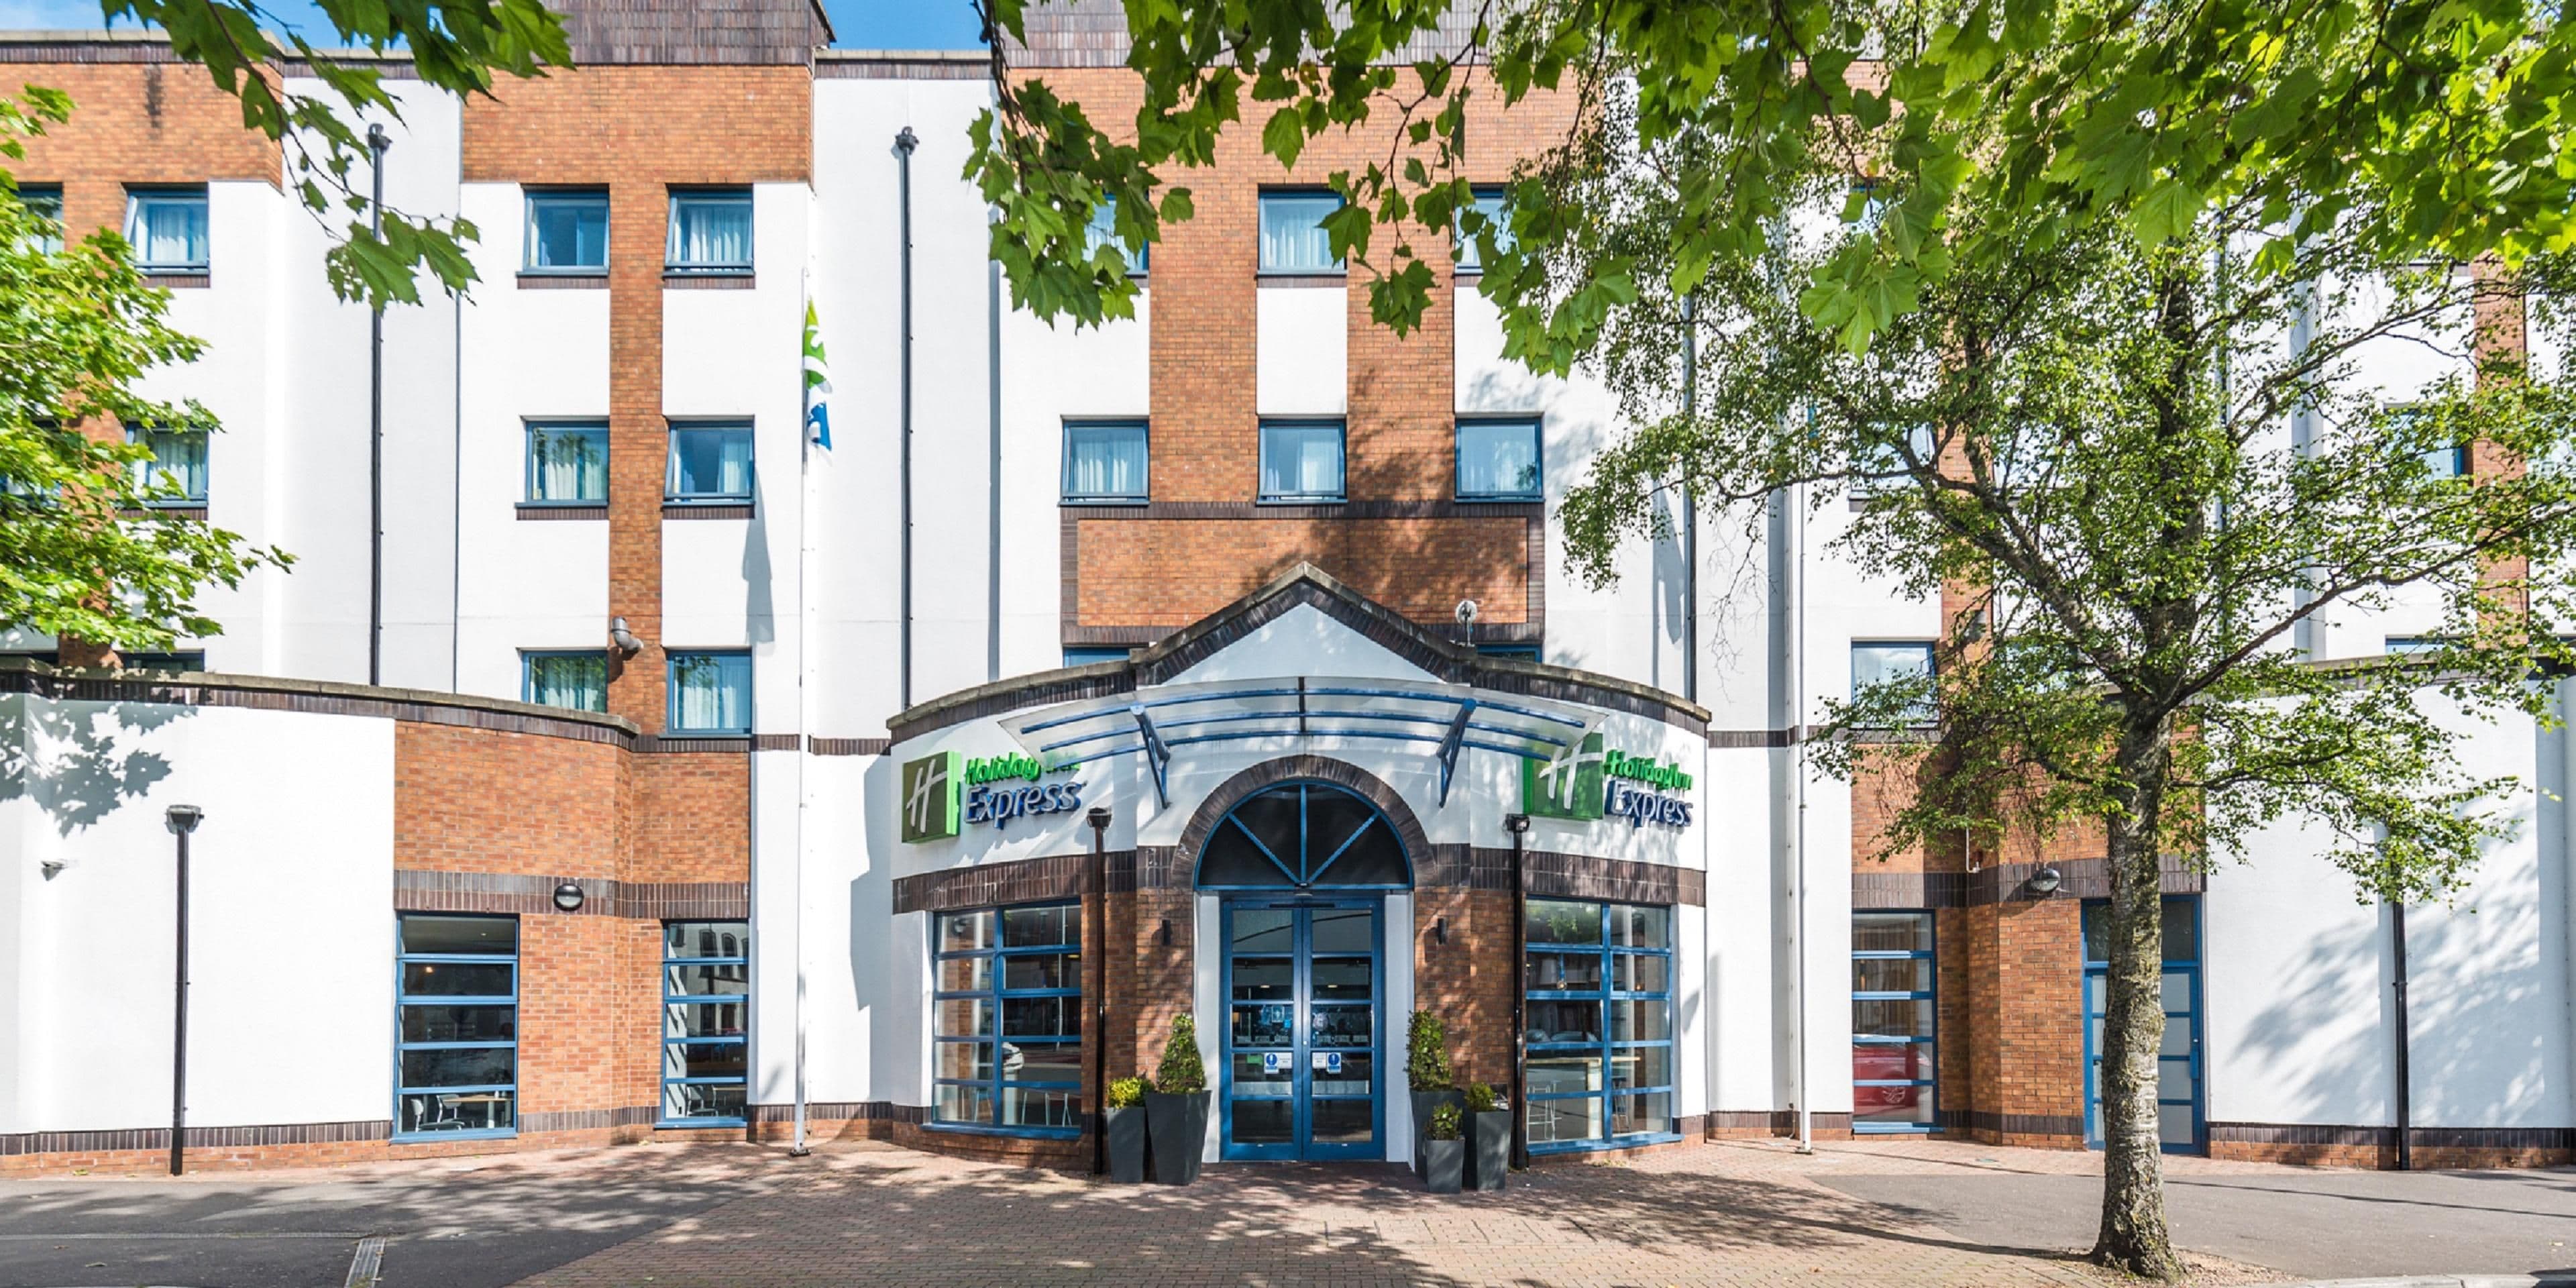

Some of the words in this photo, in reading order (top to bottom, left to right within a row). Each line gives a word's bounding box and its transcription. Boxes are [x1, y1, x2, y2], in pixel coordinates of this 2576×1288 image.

[965, 752, 1041, 785] Holiday
[1604, 749, 1677, 790] Holiday
[1674, 763, 1693, 790] Inn
[965, 782, 1082, 830] Express
[1604, 780, 1694, 828] Express
